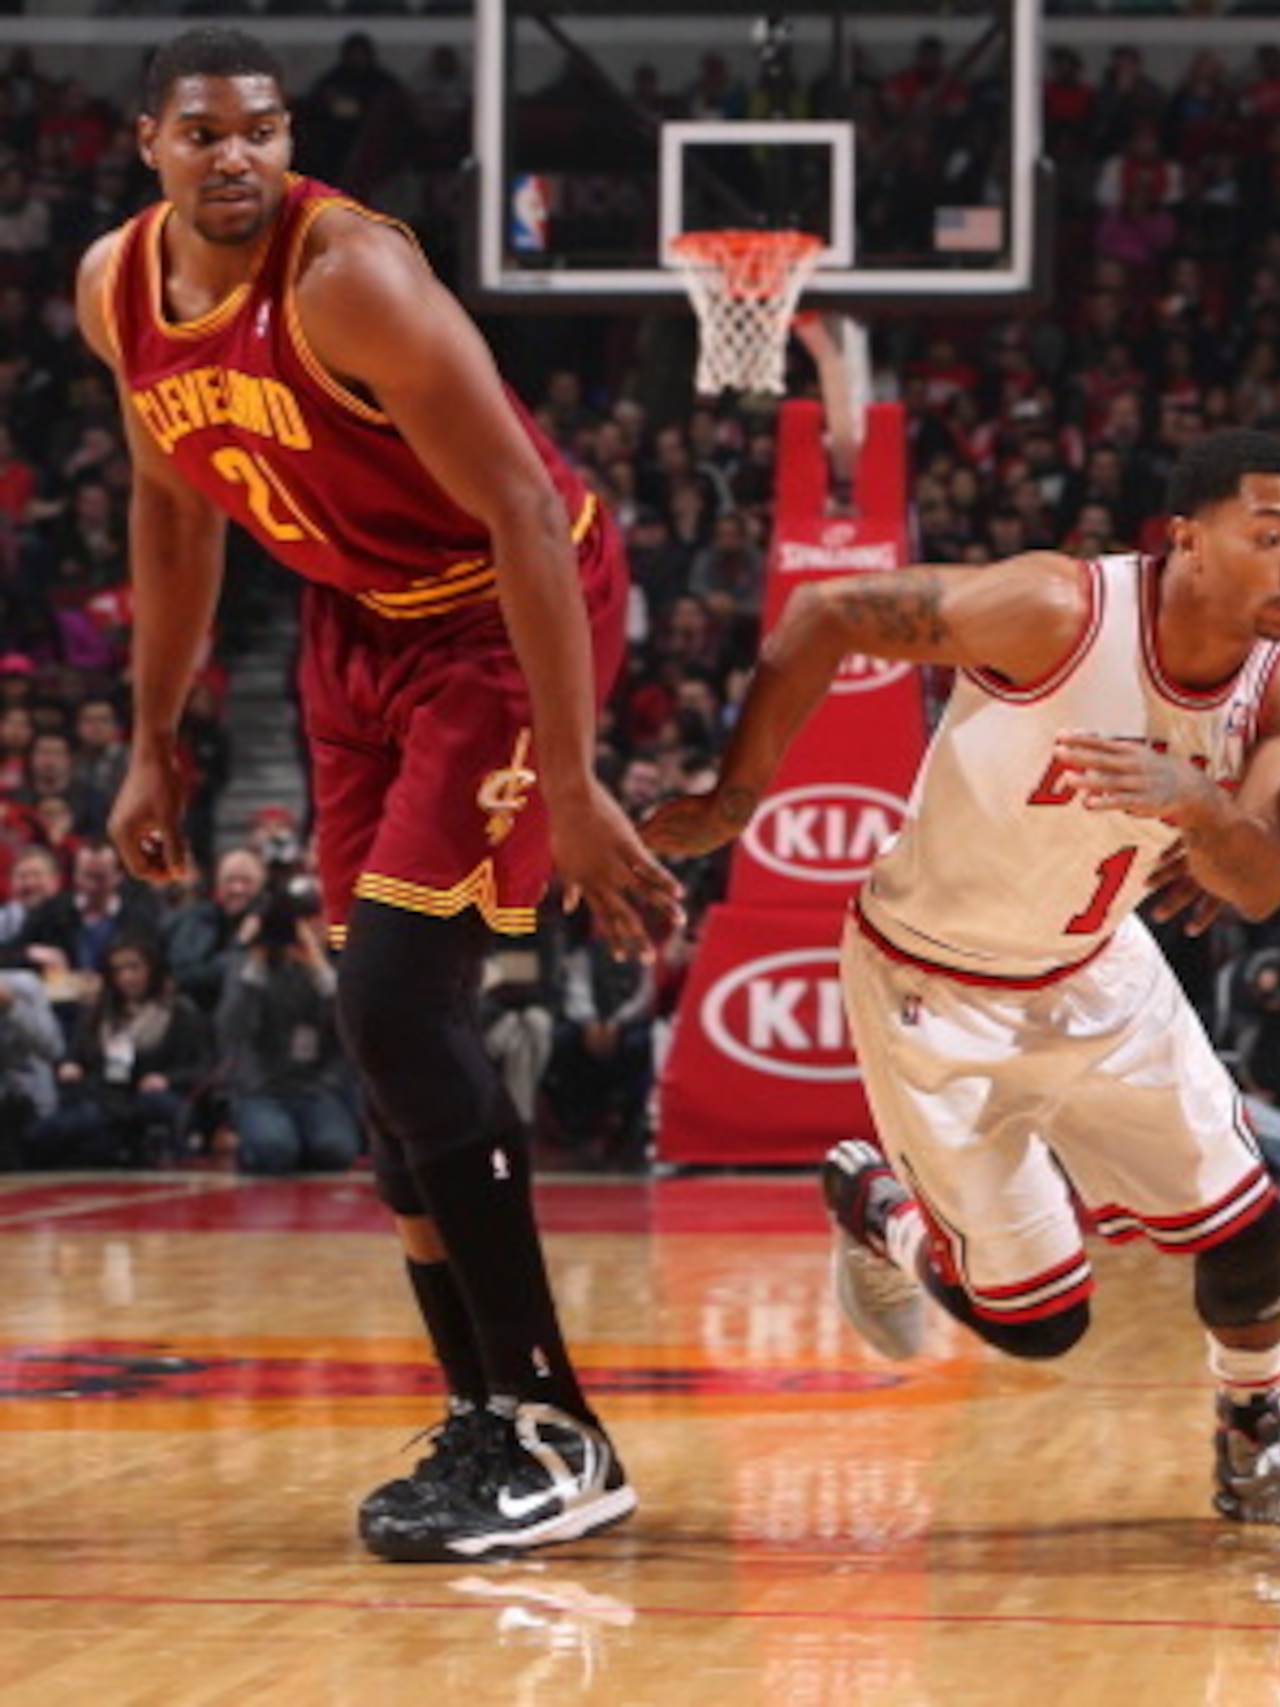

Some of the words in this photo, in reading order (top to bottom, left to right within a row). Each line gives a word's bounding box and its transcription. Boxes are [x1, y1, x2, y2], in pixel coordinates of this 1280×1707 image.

[775, 805, 890, 861] KIA
[1062, 845, 1139, 935] 1
[749, 978, 844, 1050] KI
